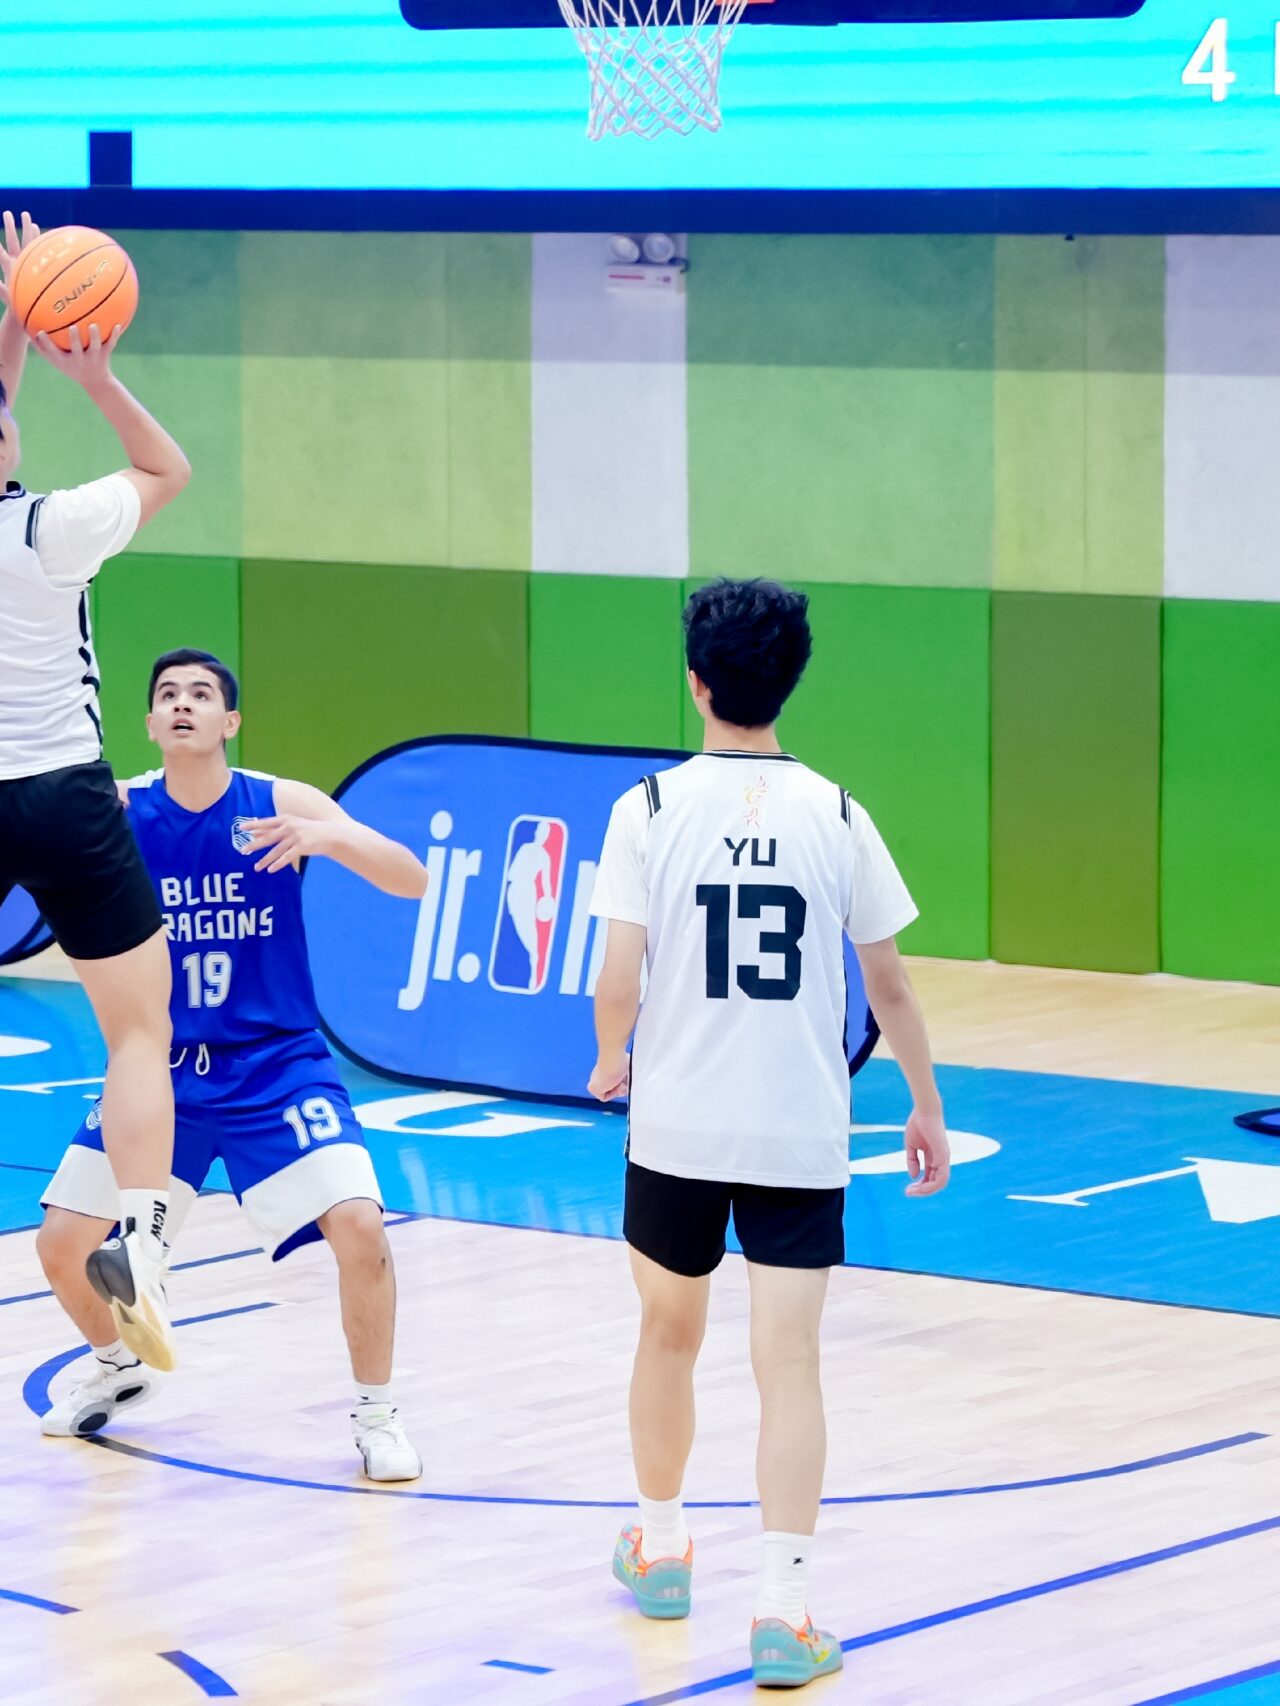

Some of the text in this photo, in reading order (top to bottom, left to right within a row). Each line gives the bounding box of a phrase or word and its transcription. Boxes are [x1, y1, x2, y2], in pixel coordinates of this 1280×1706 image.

[1181, 17, 1237, 102] 4
[723, 836, 777, 867] YU
[160, 872, 246, 907] BLUE
[397, 809, 483, 1012] jr.
[161, 905, 274, 943] RAGONS
[695, 883, 808, 1001] 13
[181, 951, 233, 1009] 19
[282, 1096, 343, 1150] 19
